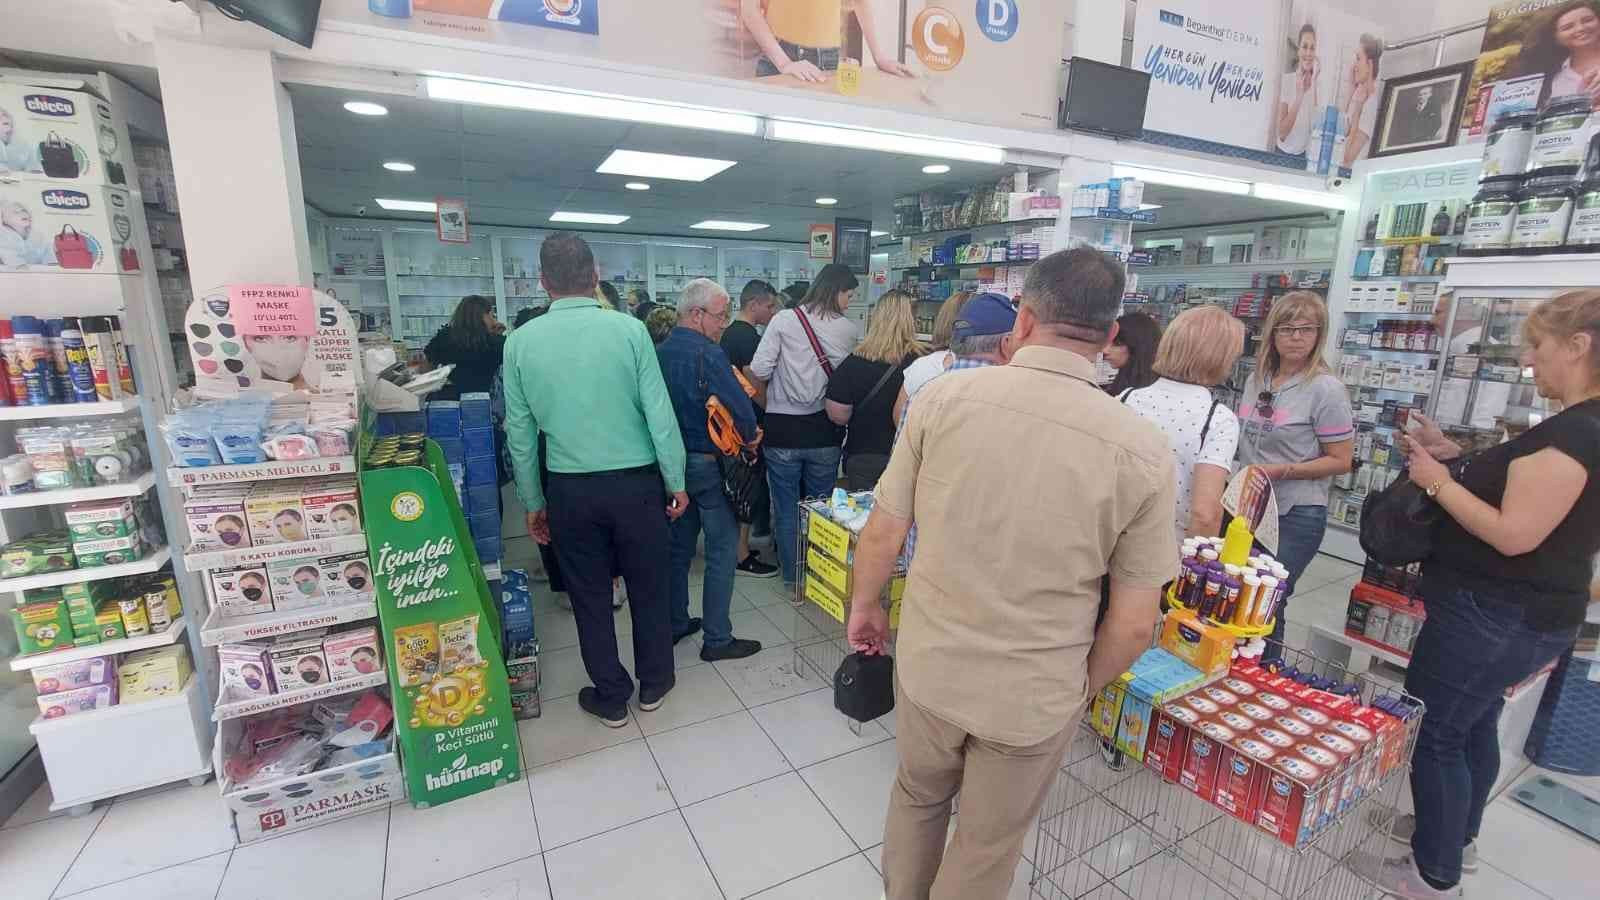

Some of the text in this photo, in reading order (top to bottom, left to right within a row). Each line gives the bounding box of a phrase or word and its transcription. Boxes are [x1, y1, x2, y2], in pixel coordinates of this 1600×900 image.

[923, 14, 950, 55] C
[1163, 48, 1206, 66] HER GÜN
[1226, 63, 1243, 77] HER
[25, 96, 74, 116] chicco
[44, 191, 89, 208] chicco
[241, 289, 300, 298] FFP2 RENKLİ
[256, 302, 289, 310] MASKE
[319, 306, 338, 327] 5
[313, 336, 351, 347] SÜPER
[315, 352, 353, 361] MASKE
[201, 463, 326, 481] PARMASK MEDICAL
[279, 546, 318, 557] KORUMA
[375, 536, 455, 577] İçindeki
[387, 562, 449, 597] iyiliğe
[244, 625, 281, 637] YÜKSEK
[439, 685, 461, 708] D
[434, 716, 499, 743] D Vitaminli
[437, 729, 495, 754] Keçi Sütlü
[425, 756, 504, 792] hünnap
[292, 783, 388, 816] PARMASK
